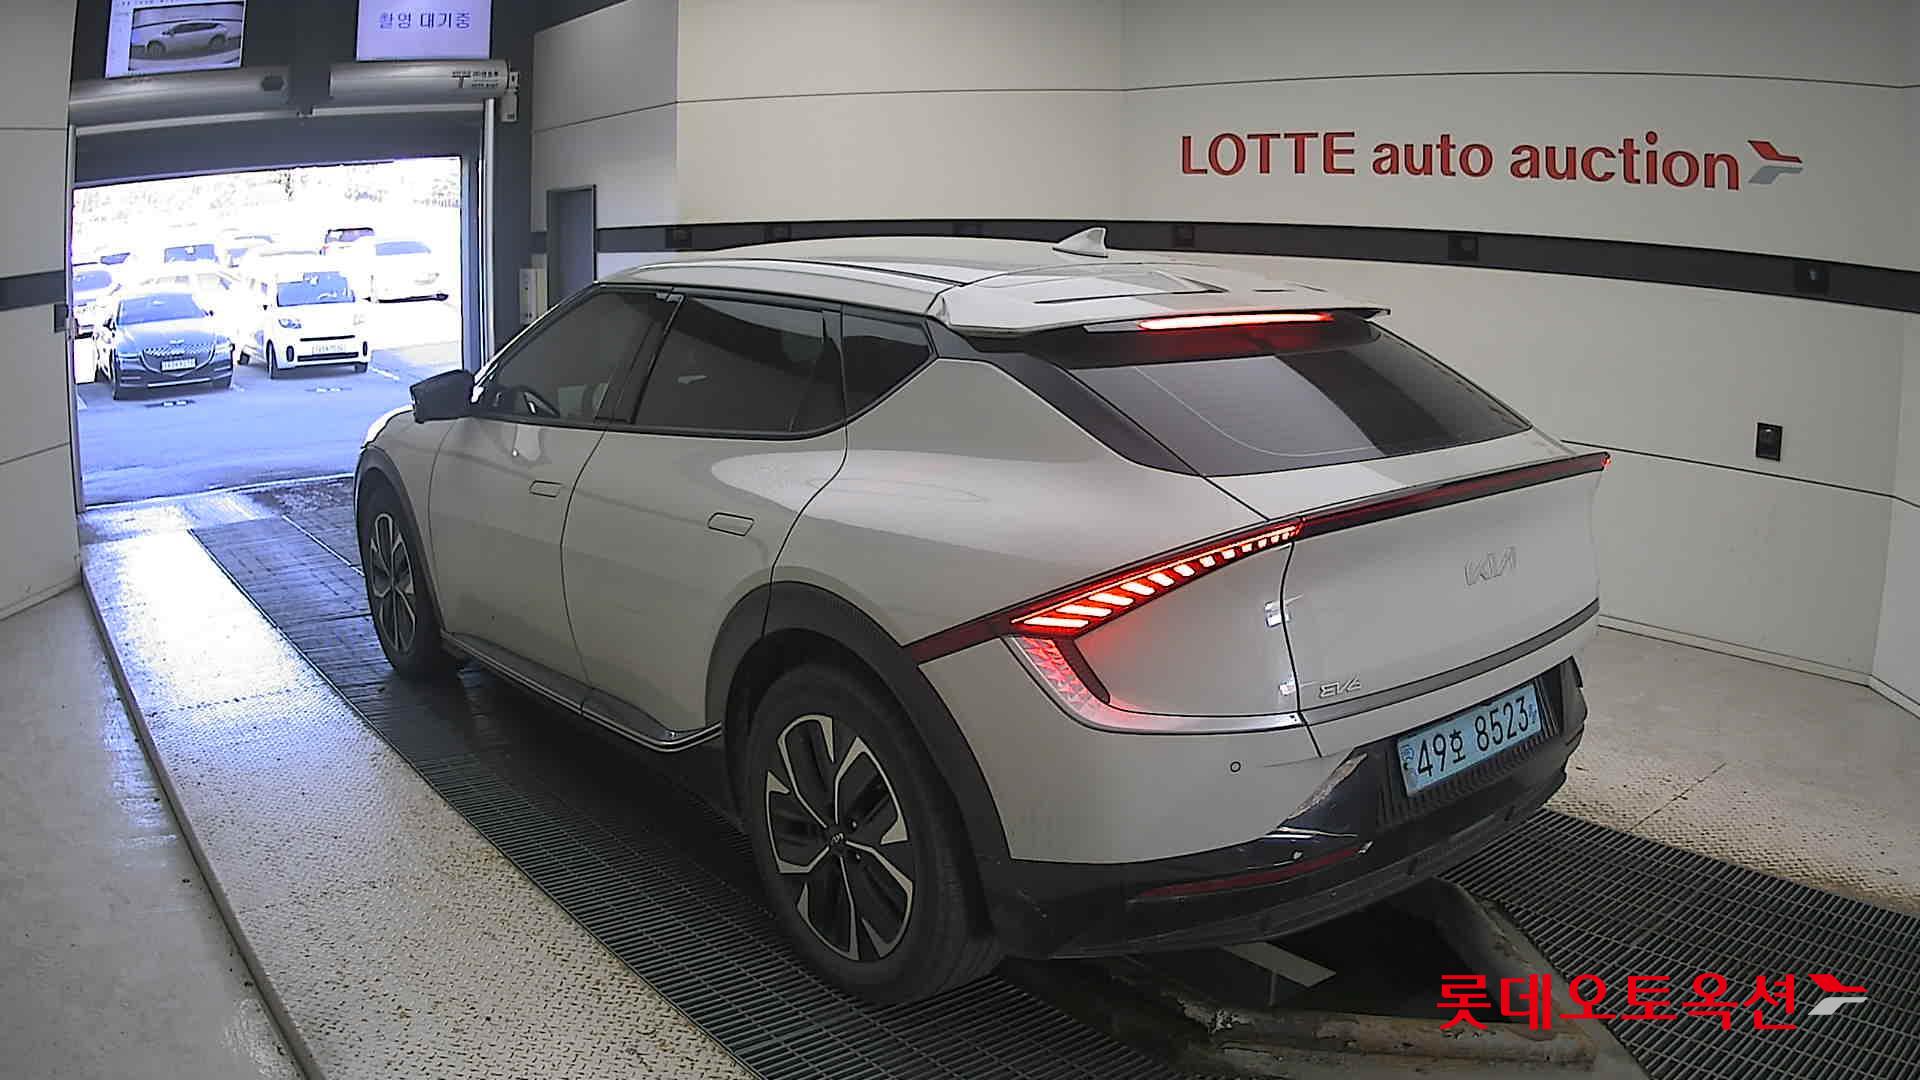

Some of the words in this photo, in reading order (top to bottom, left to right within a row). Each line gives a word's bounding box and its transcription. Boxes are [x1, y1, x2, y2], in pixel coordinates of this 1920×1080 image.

[420, 11, 471, 29] 대기중
[1181, 131, 1355, 176] LOTTE
[1371, 133, 1493, 177] auto
[1510, 131, 1739, 190] auction
[1417, 728, 1467, 778] 49호
[1474, 695, 1530, 752] 8523
